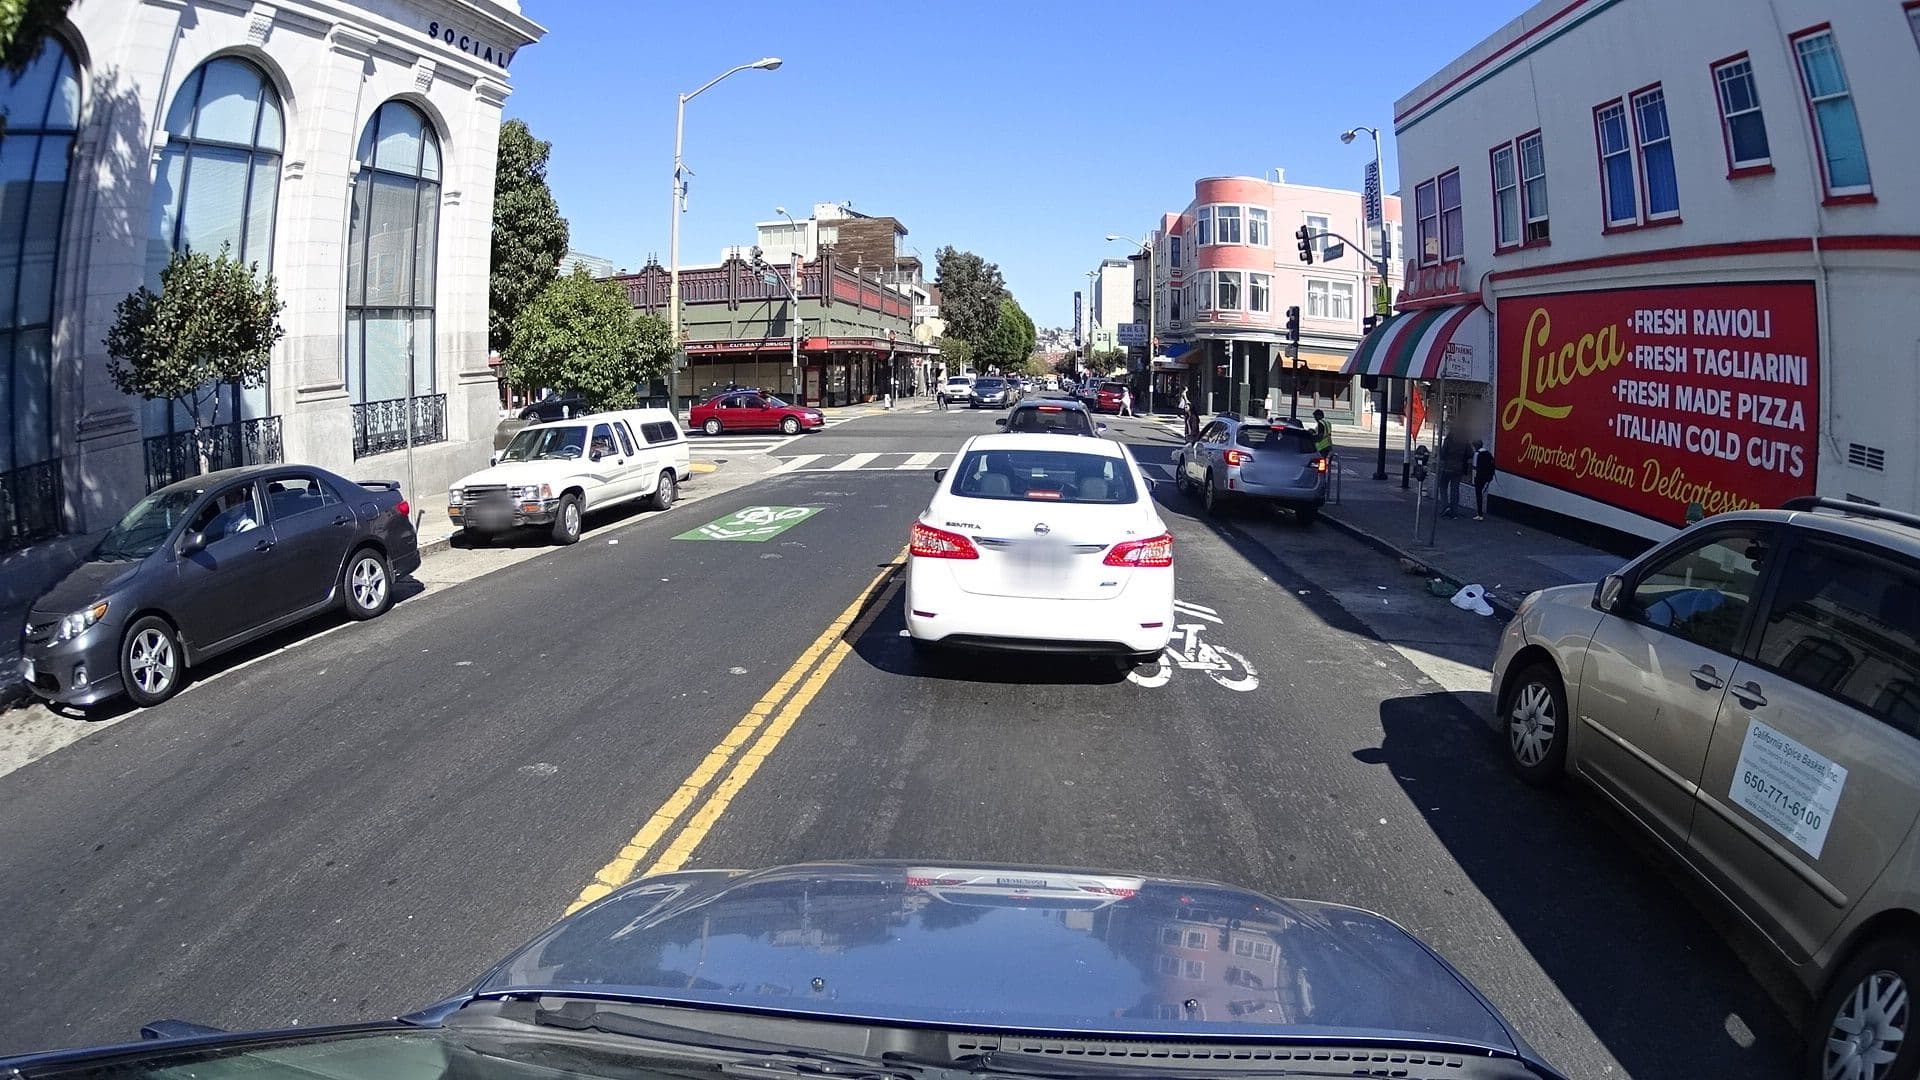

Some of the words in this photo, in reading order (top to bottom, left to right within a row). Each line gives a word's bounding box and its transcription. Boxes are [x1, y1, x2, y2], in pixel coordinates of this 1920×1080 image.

[428, 21, 505, 69] SOCIAL
[1634, 308, 1687, 335] FRESH
[1693, 308, 1771, 339] RAVIOLI
[1502, 307, 1626, 431] Lucca
[1634, 345, 1688, 373] FRESH
[1693, 348, 1808, 386] TAGLIARINI
[1618, 379, 1669, 409] FRESH
[1675, 384, 1731, 419] MADE
[1737, 392, 1805, 432] PIZZA
[1616, 413, 1681, 448] ITALIAN
[1685, 425, 1741, 461] COLD
[1746, 436, 1804, 478] CUTS
[1518, 432, 1577, 469] Imported
[1576, 446, 1636, 489] Italian
[1641, 458, 1760, 514] Delicatessen
[945, 521, 982, 530] SENTRA
[1753, 726, 1783, 750] California
[1783, 743, 1802, 760] Spice
[1744, 771, 1821, 830] 650-771-6100
